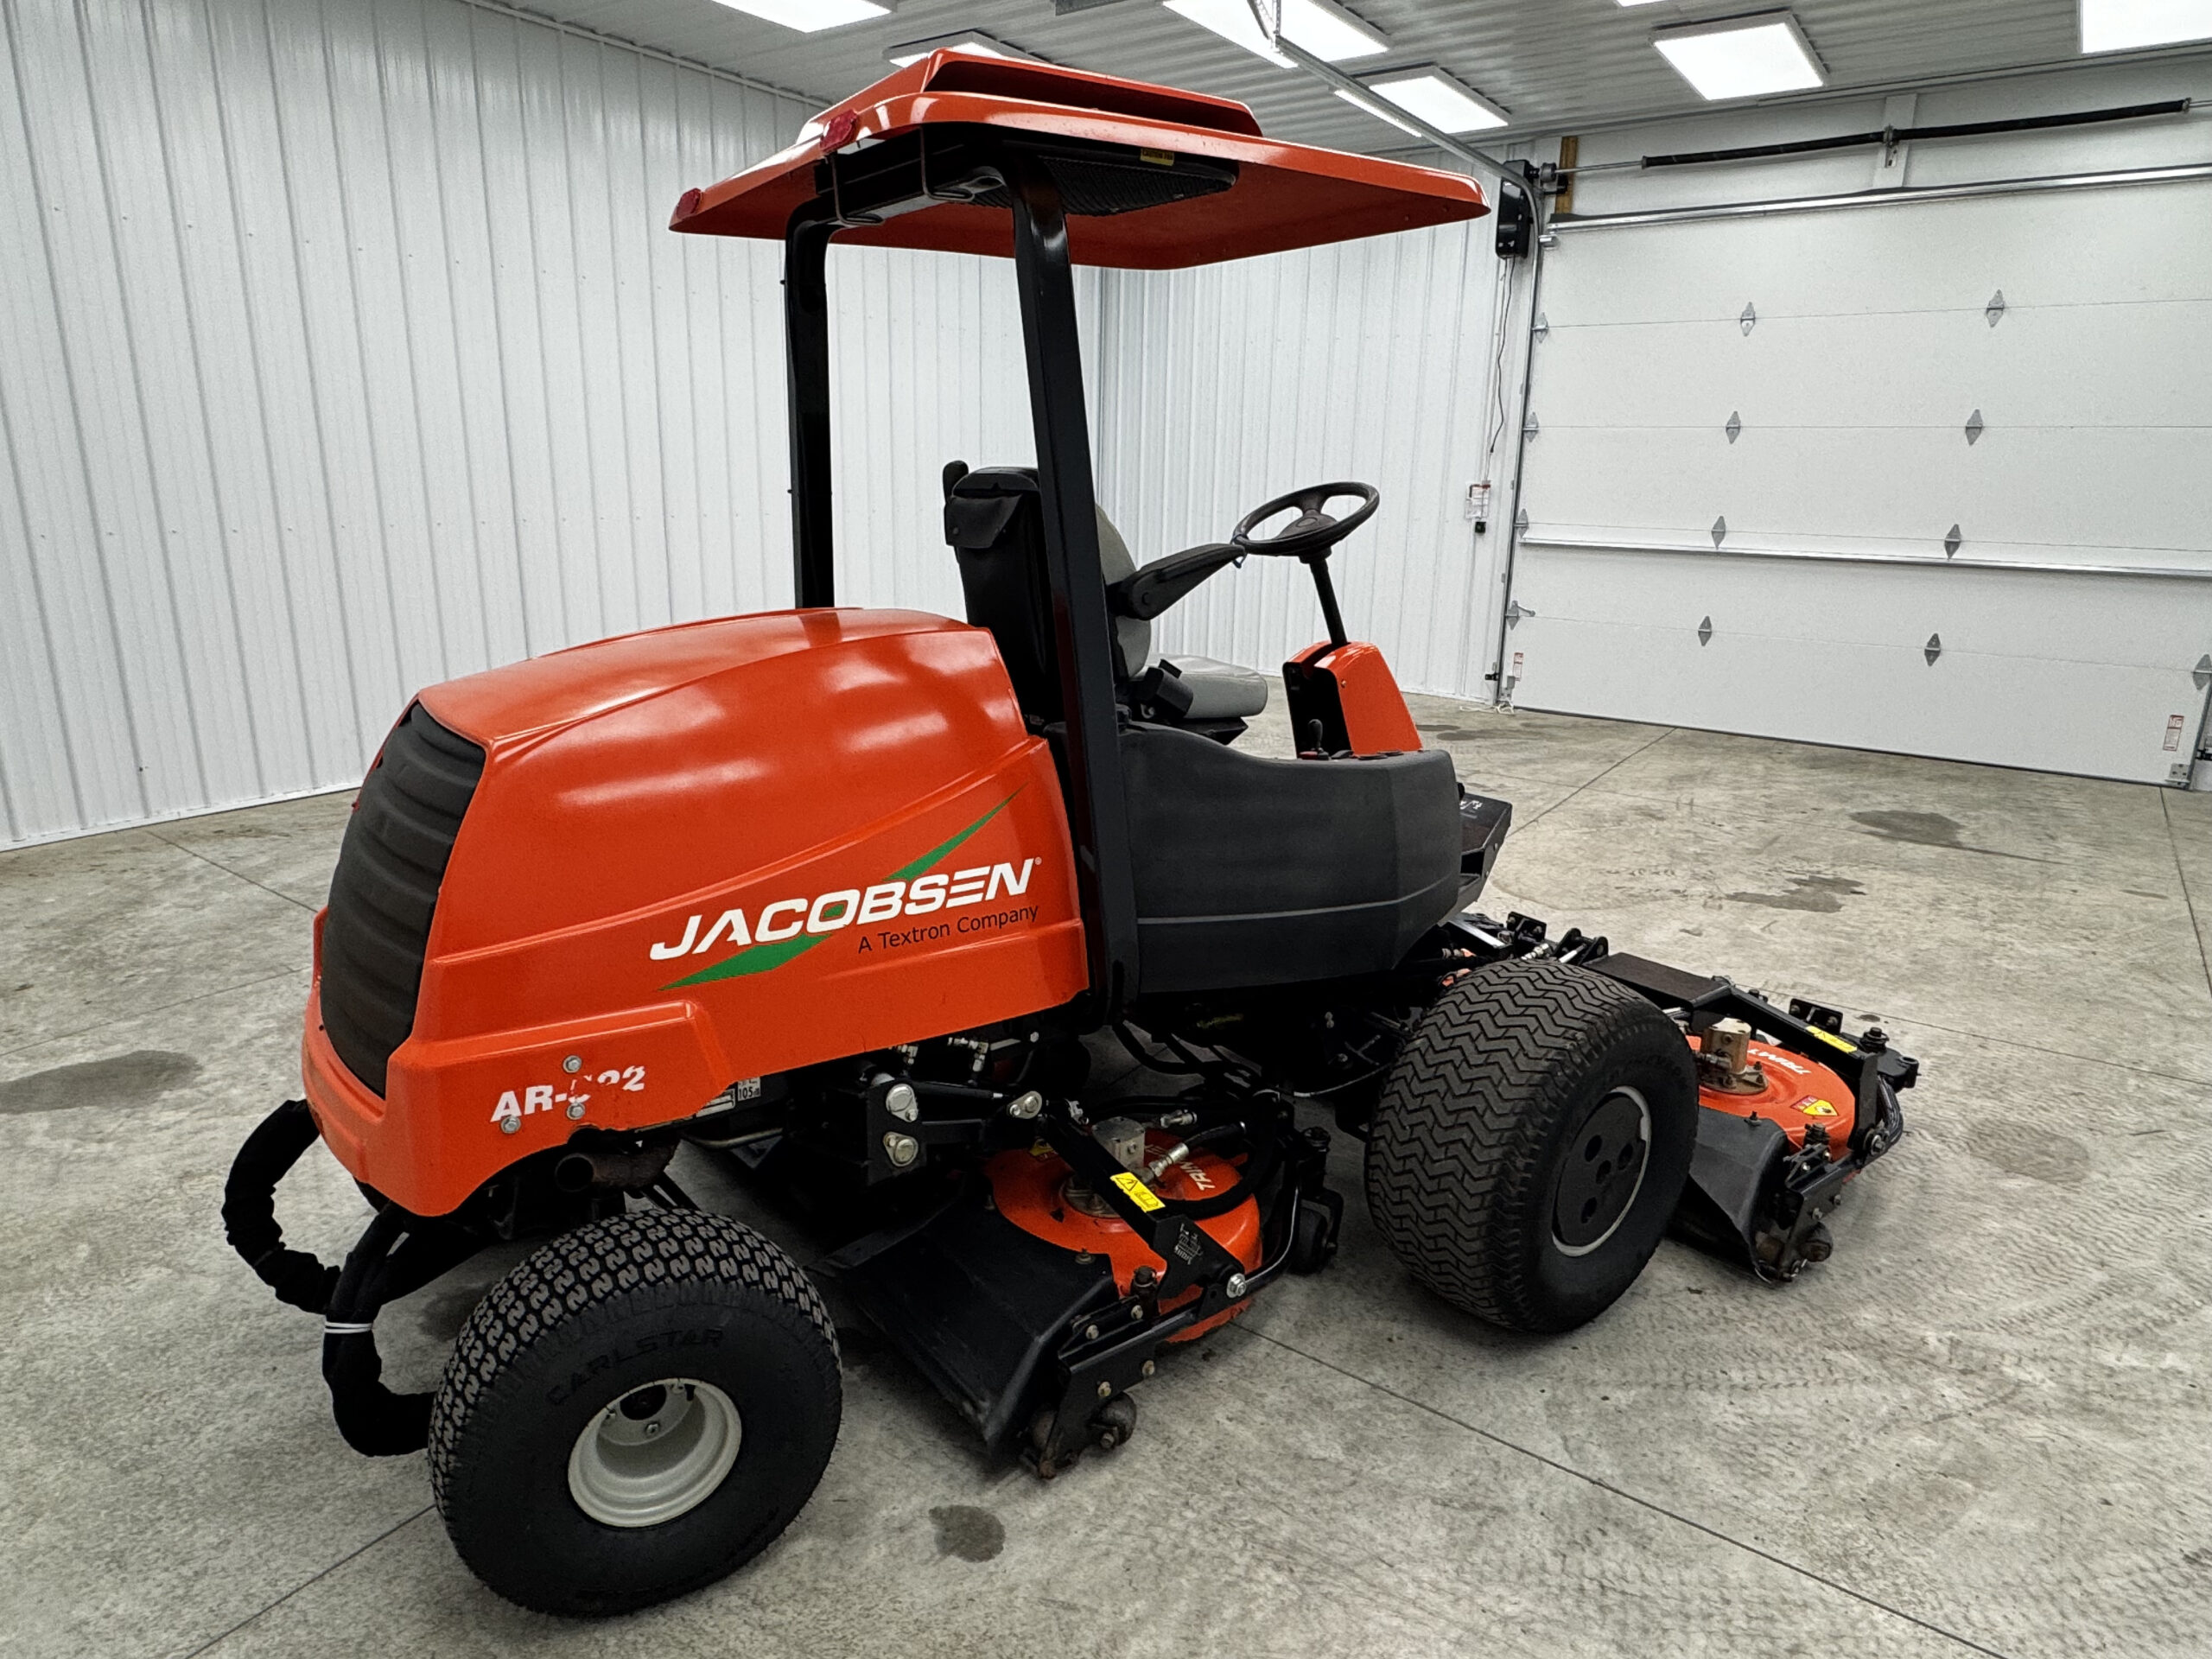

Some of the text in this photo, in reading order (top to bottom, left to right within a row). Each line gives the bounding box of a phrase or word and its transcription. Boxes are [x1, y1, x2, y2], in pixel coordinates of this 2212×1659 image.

[650, 858, 1034, 960] JACOBSEN
[858, 906, 1039, 954] A Textron Company
[545, 1328, 723, 1405] CARLSTAR
